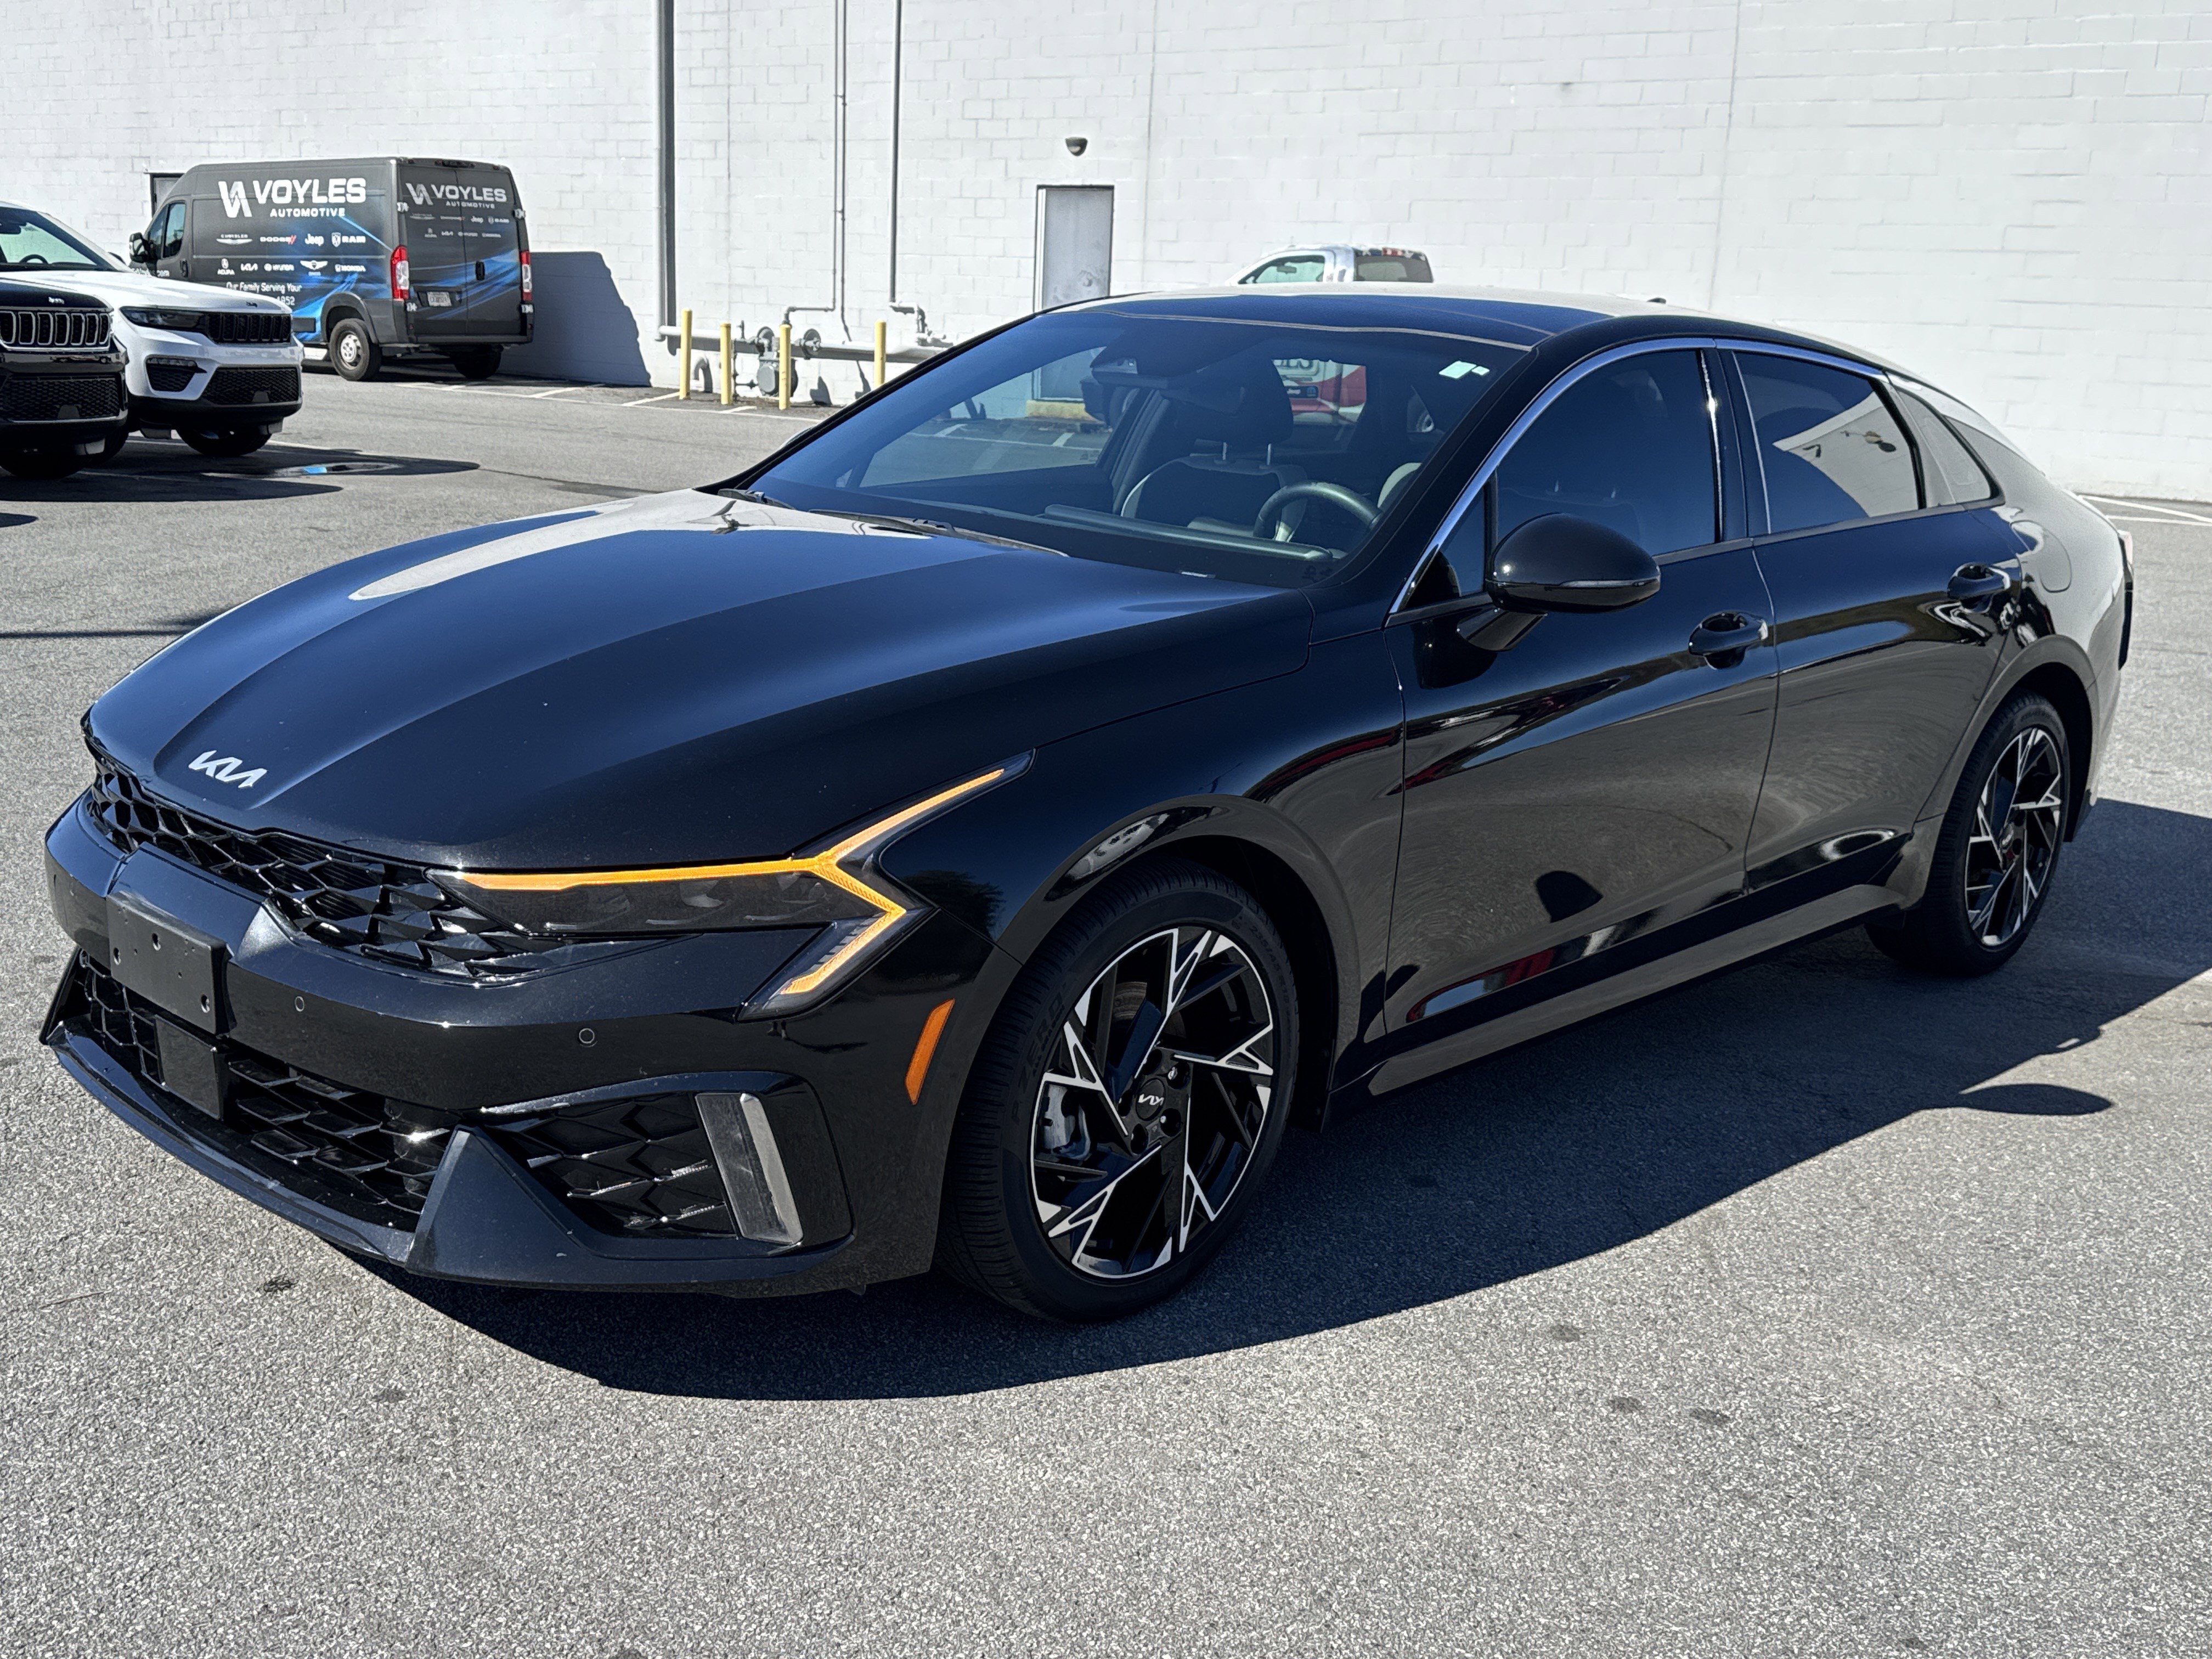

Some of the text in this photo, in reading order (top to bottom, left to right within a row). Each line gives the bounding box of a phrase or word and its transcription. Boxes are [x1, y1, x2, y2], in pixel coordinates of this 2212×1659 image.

[253, 178, 366, 204] VOYLES
[431, 183, 507, 202] VOYLES
[445, 201, 495, 209] AUTOMOTIVE
[269, 208, 345, 218] AUTOMOTIVE
[304, 233, 324, 247] Jeep
[240, 281, 259, 294] Family
[261, 282, 285, 294] Serving
[287, 282, 302, 292] Your
[188, 749, 268, 788] KIA
